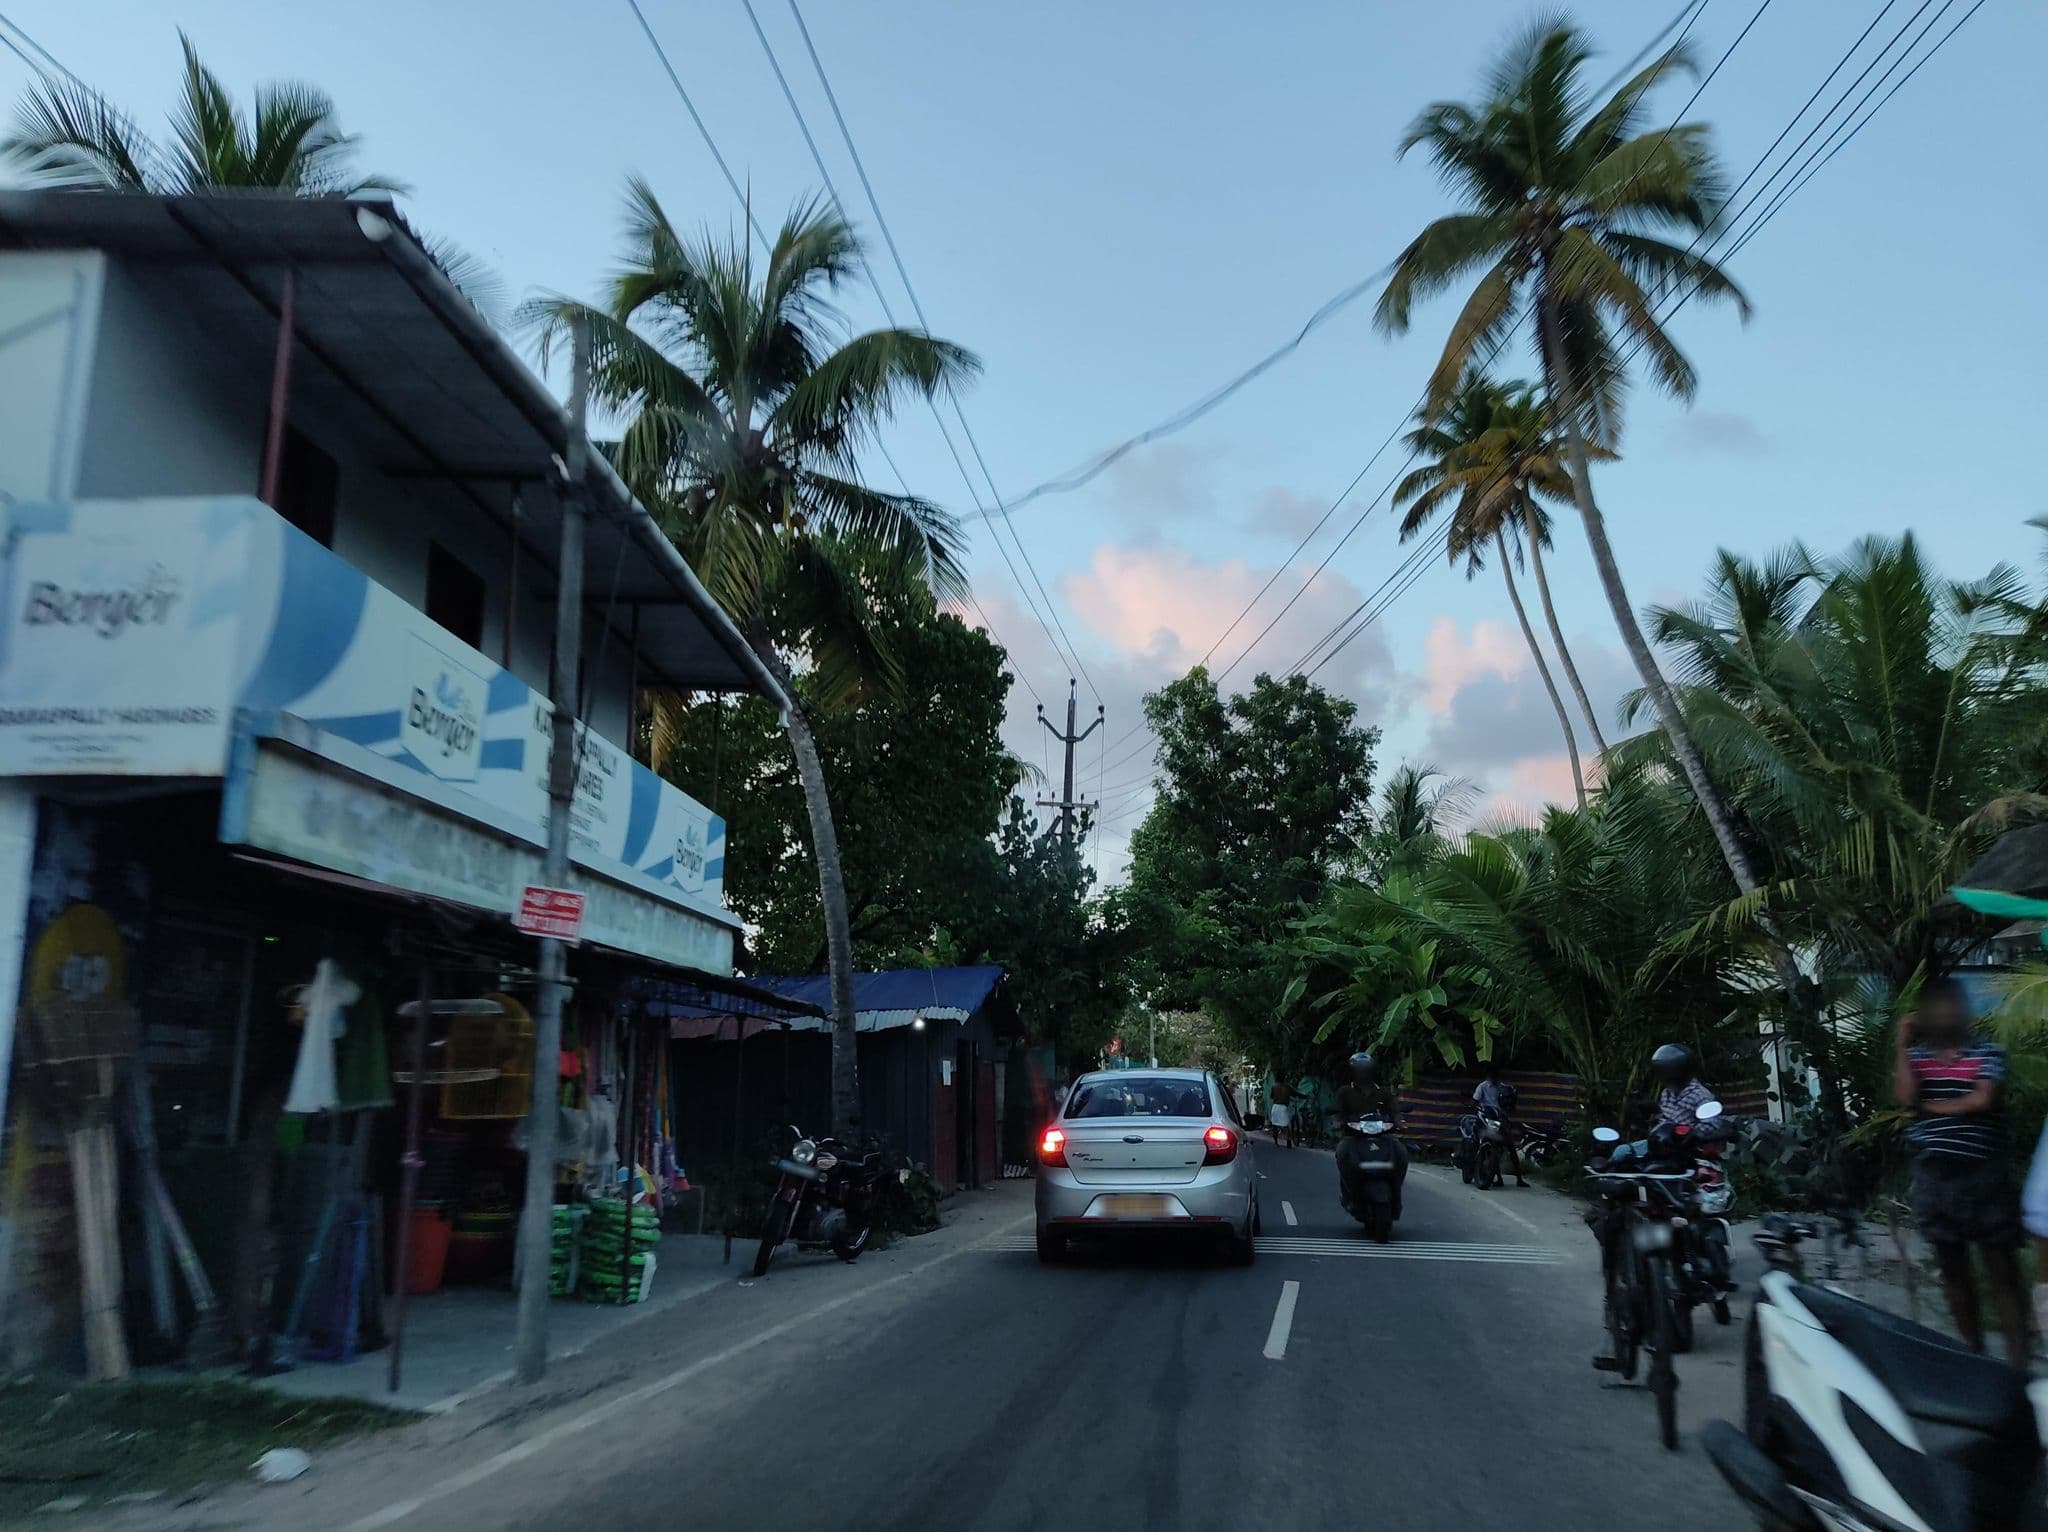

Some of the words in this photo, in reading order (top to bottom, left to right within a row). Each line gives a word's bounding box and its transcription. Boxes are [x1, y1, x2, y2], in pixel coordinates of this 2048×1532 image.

[24, 579, 177, 639] Berger
[408, 686, 475, 758] Berger
[676, 838, 703, 879] Berger
